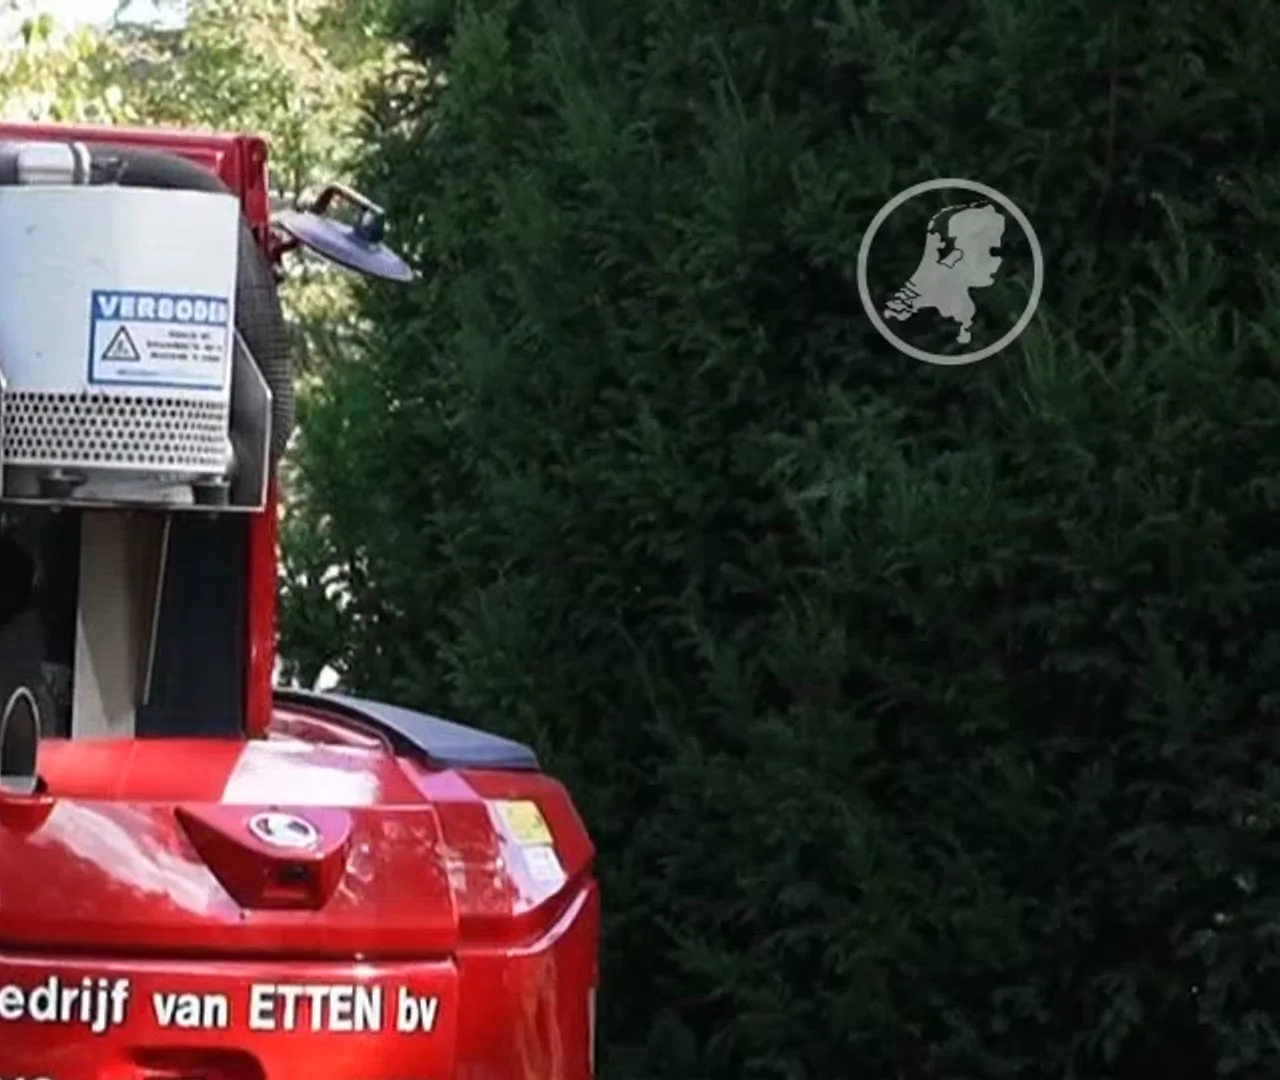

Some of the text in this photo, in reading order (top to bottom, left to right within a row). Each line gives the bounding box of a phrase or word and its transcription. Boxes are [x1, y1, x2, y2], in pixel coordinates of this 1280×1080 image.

[152, 991, 229, 1029] van
[248, 983, 382, 1033] ETTEN
[396, 985, 438, 1033] bv
